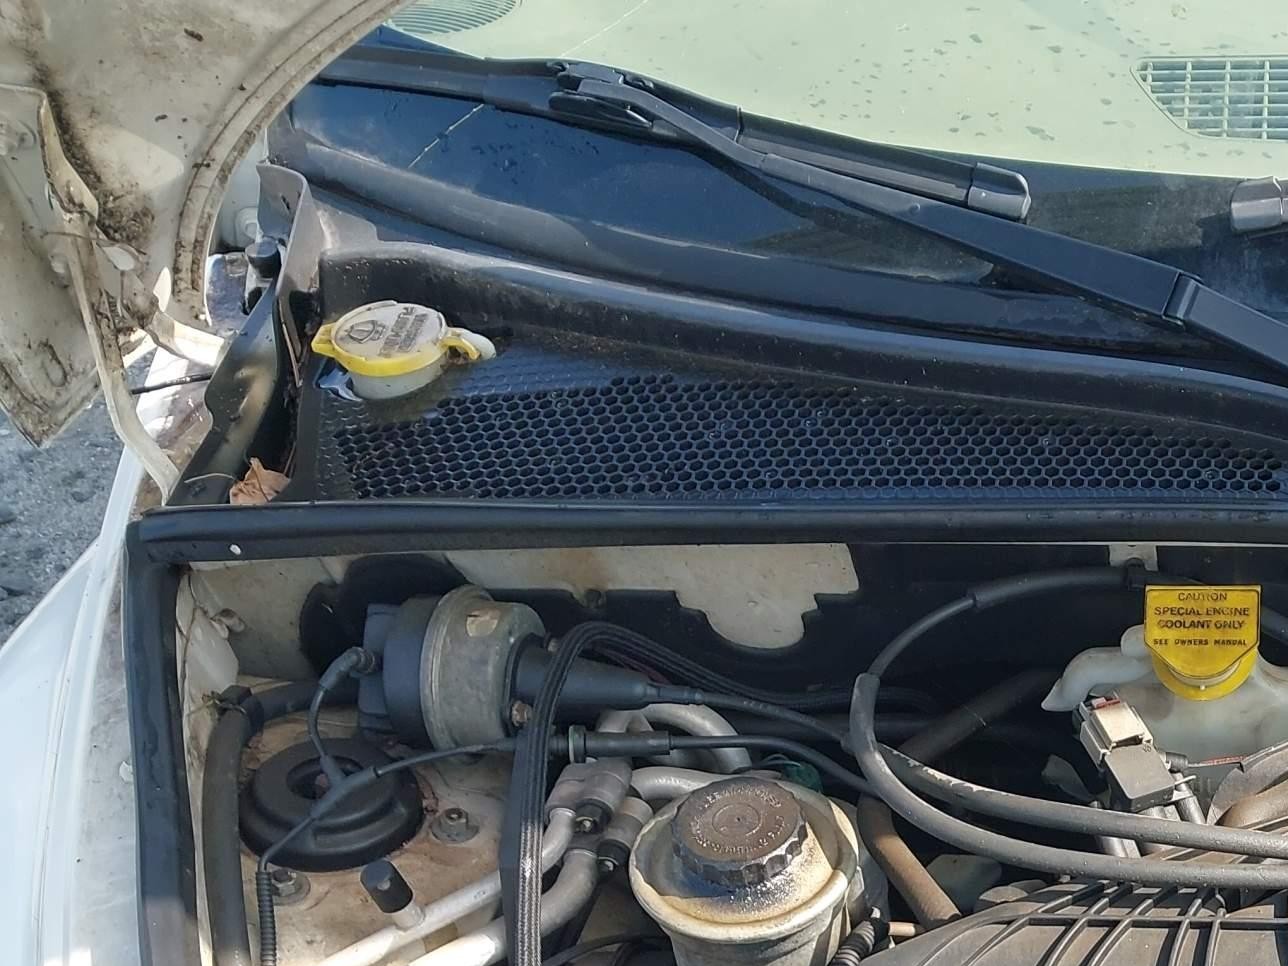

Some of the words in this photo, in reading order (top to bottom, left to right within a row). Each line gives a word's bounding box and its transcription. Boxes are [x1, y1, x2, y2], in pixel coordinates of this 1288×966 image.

[1178, 592, 1228, 602] CAUTION
[1154, 606, 1202, 616] SPECIAL
[1206, 607, 1250, 616] ENGINE
[1158, 620, 1211, 630] COOLANT
[1214, 620, 1245, 630] ONLY
[1153, 638, 1169, 646] SEE
[1174, 638, 1209, 646] OWNERS
[1213, 638, 1248, 646] MANUAL
